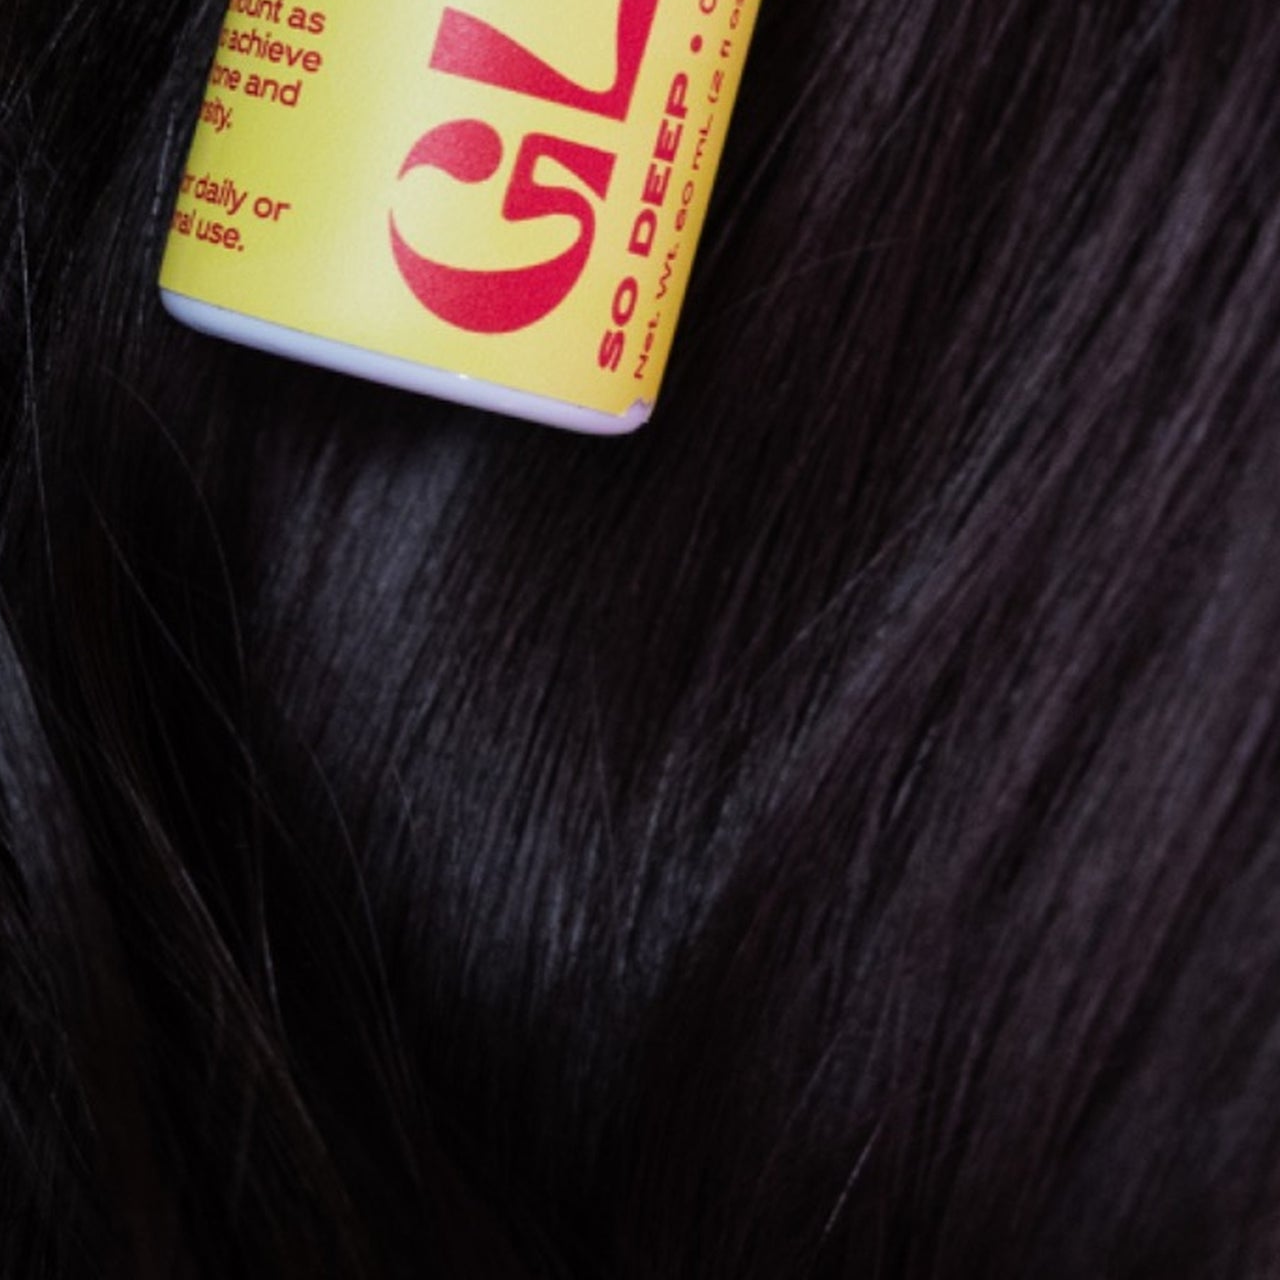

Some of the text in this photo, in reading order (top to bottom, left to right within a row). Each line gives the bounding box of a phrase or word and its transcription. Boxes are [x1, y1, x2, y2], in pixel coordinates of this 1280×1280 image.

[286, 6, 326, 35] as
[227, 30, 323, 74] achieve
[243, 73, 302, 107] and
[194, 176, 248, 216] daily
[252, 196, 290, 221] or
[195, 221, 244, 251] use.
[596, 275, 641, 373] SO
[626, 70, 691, 259] DEEP
[632, 312, 661, 382] Net.
